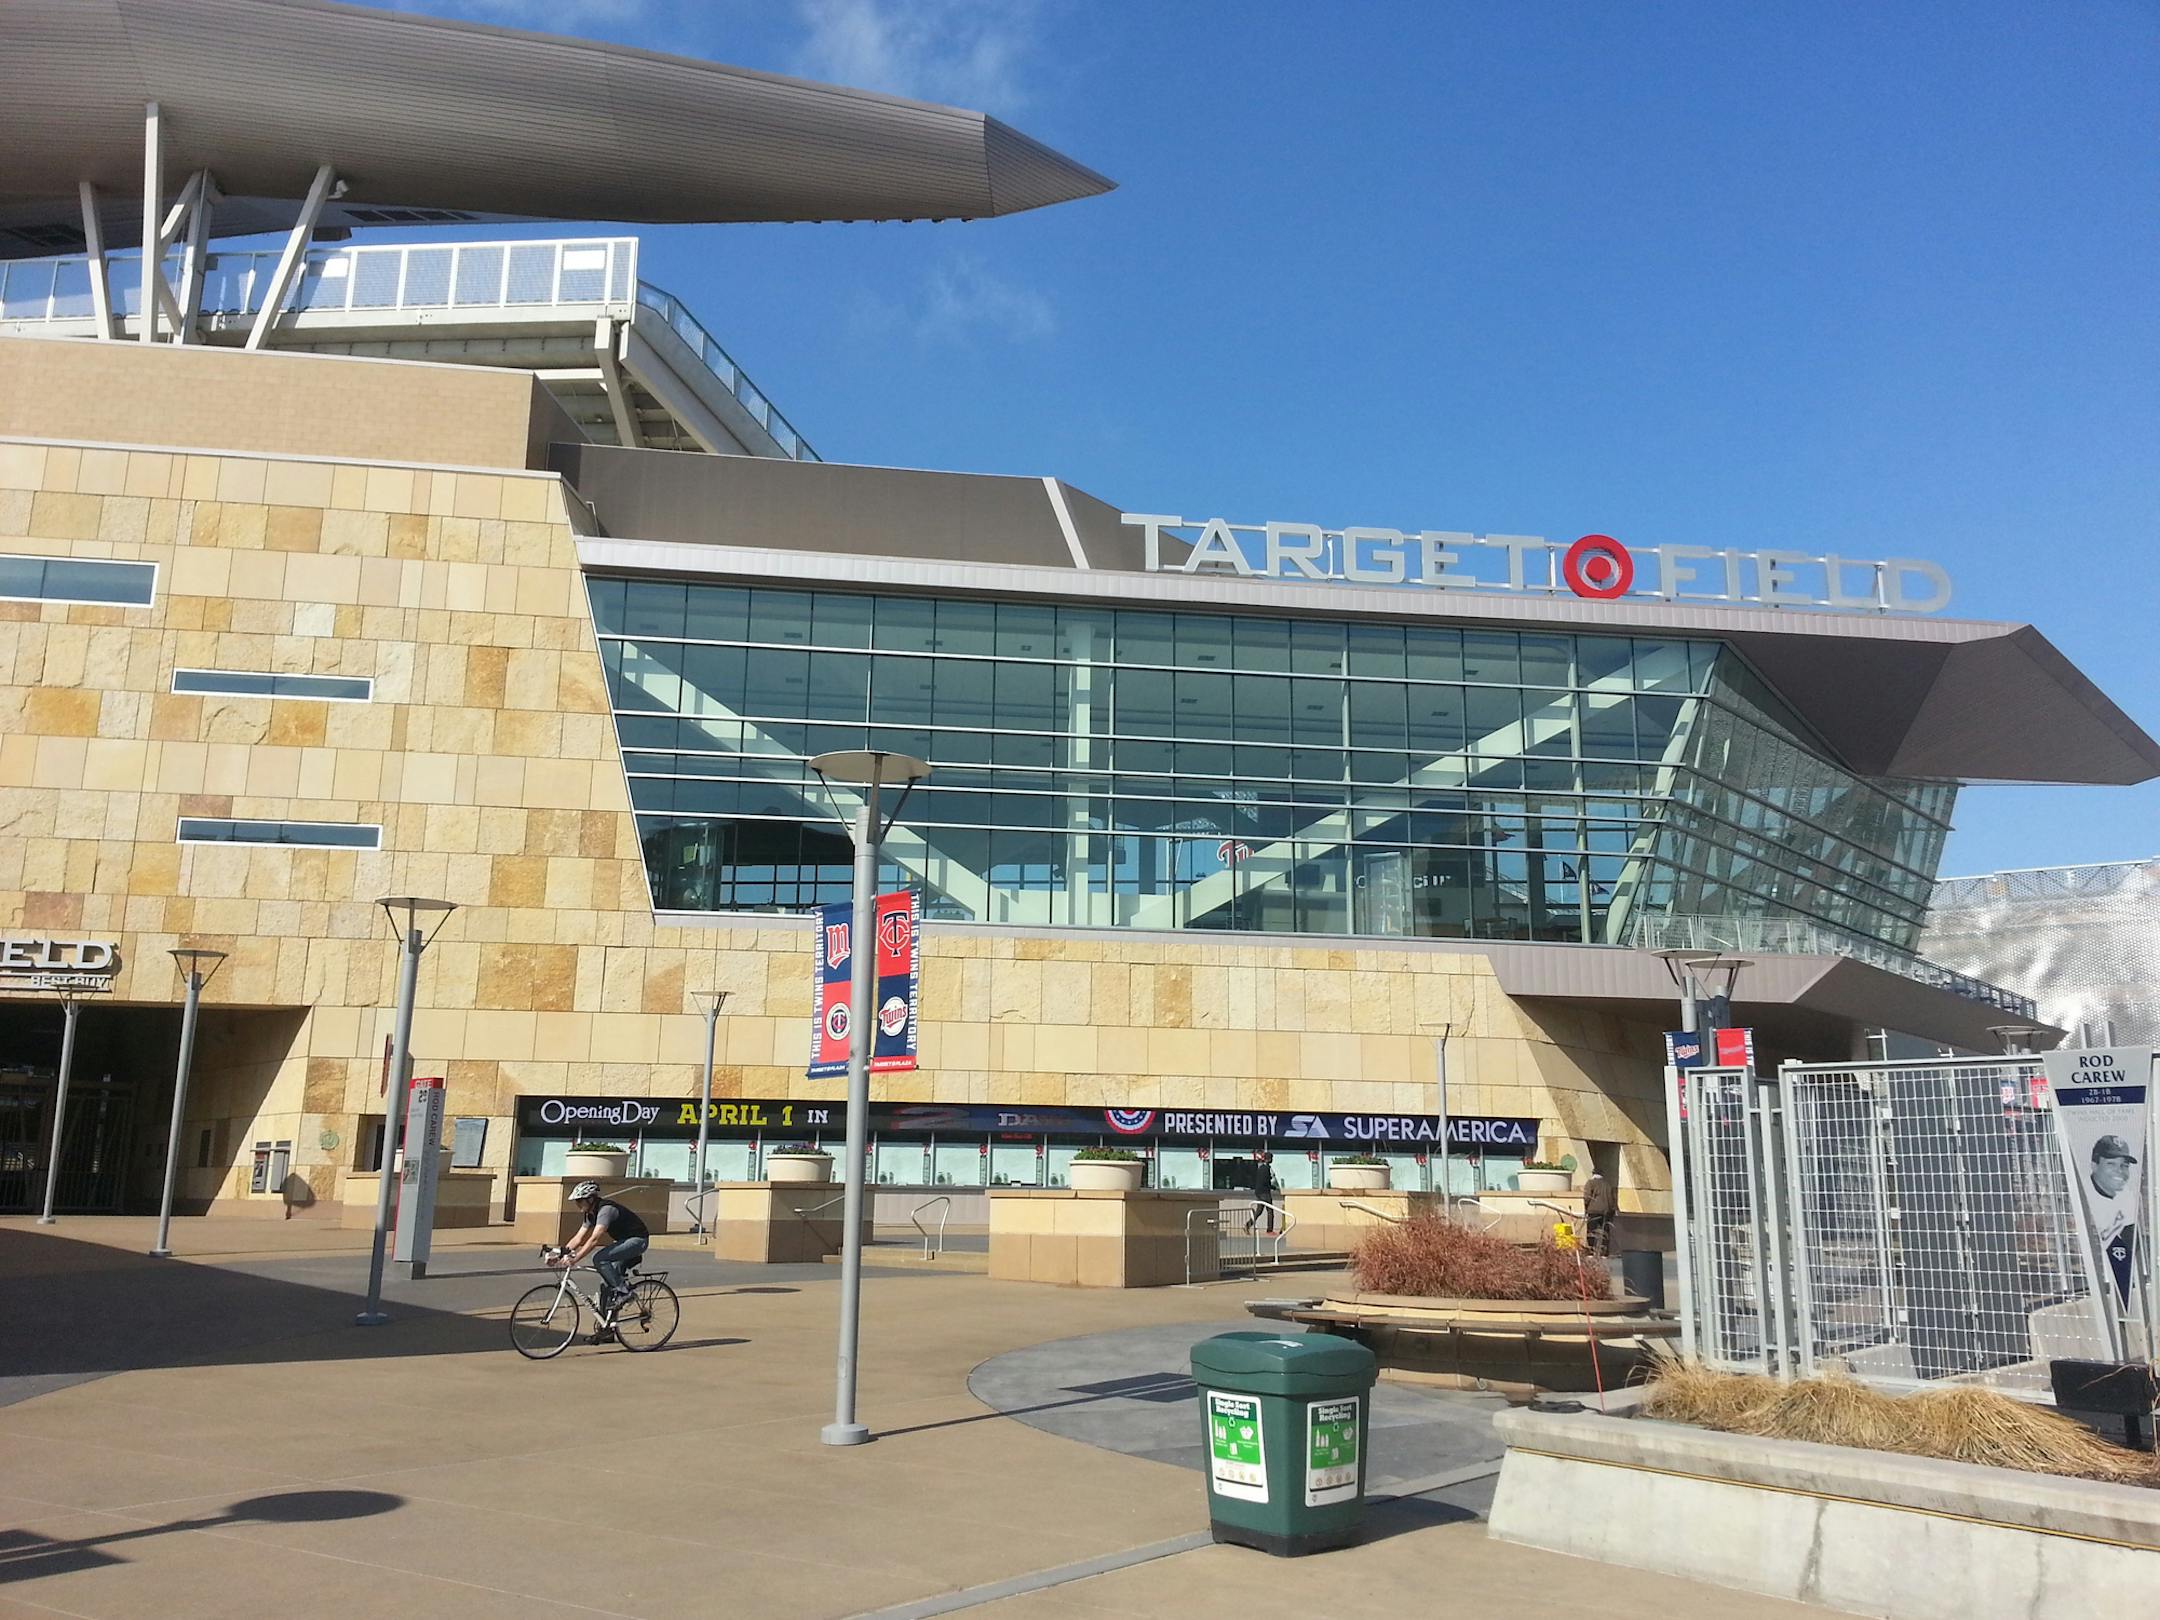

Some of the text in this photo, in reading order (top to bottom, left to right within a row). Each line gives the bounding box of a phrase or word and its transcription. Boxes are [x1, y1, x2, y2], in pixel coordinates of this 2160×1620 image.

[1120, 512, 1952, 613] TARGET FIELD
[906, 893, 919, 1051] THIS IS TWINS TERRITORY
[811, 911, 824, 1059] THIS IS TWINS TERRITORY
[879, 1005, 908, 1029] Twins
[2079, 1054, 2114, 1068] ROD
[2071, 1070, 2126, 1084] CAREW
[677, 1103, 768, 1126] APRIL
[782, 1105, 793, 1126] 1
[807, 1109, 829, 1124] IN
[1164, 1112, 1528, 1144] PRESENTED BY SA SUPERAMERICA
[689, 1140, 698, 1151] 3
[1215, 1398, 1251, 1410] Single Sort
[1318, 1406, 1339, 1416] Single
[1215, 1405, 1249, 1419] Recycling
[1320, 1412, 1351, 1422] Recycling
